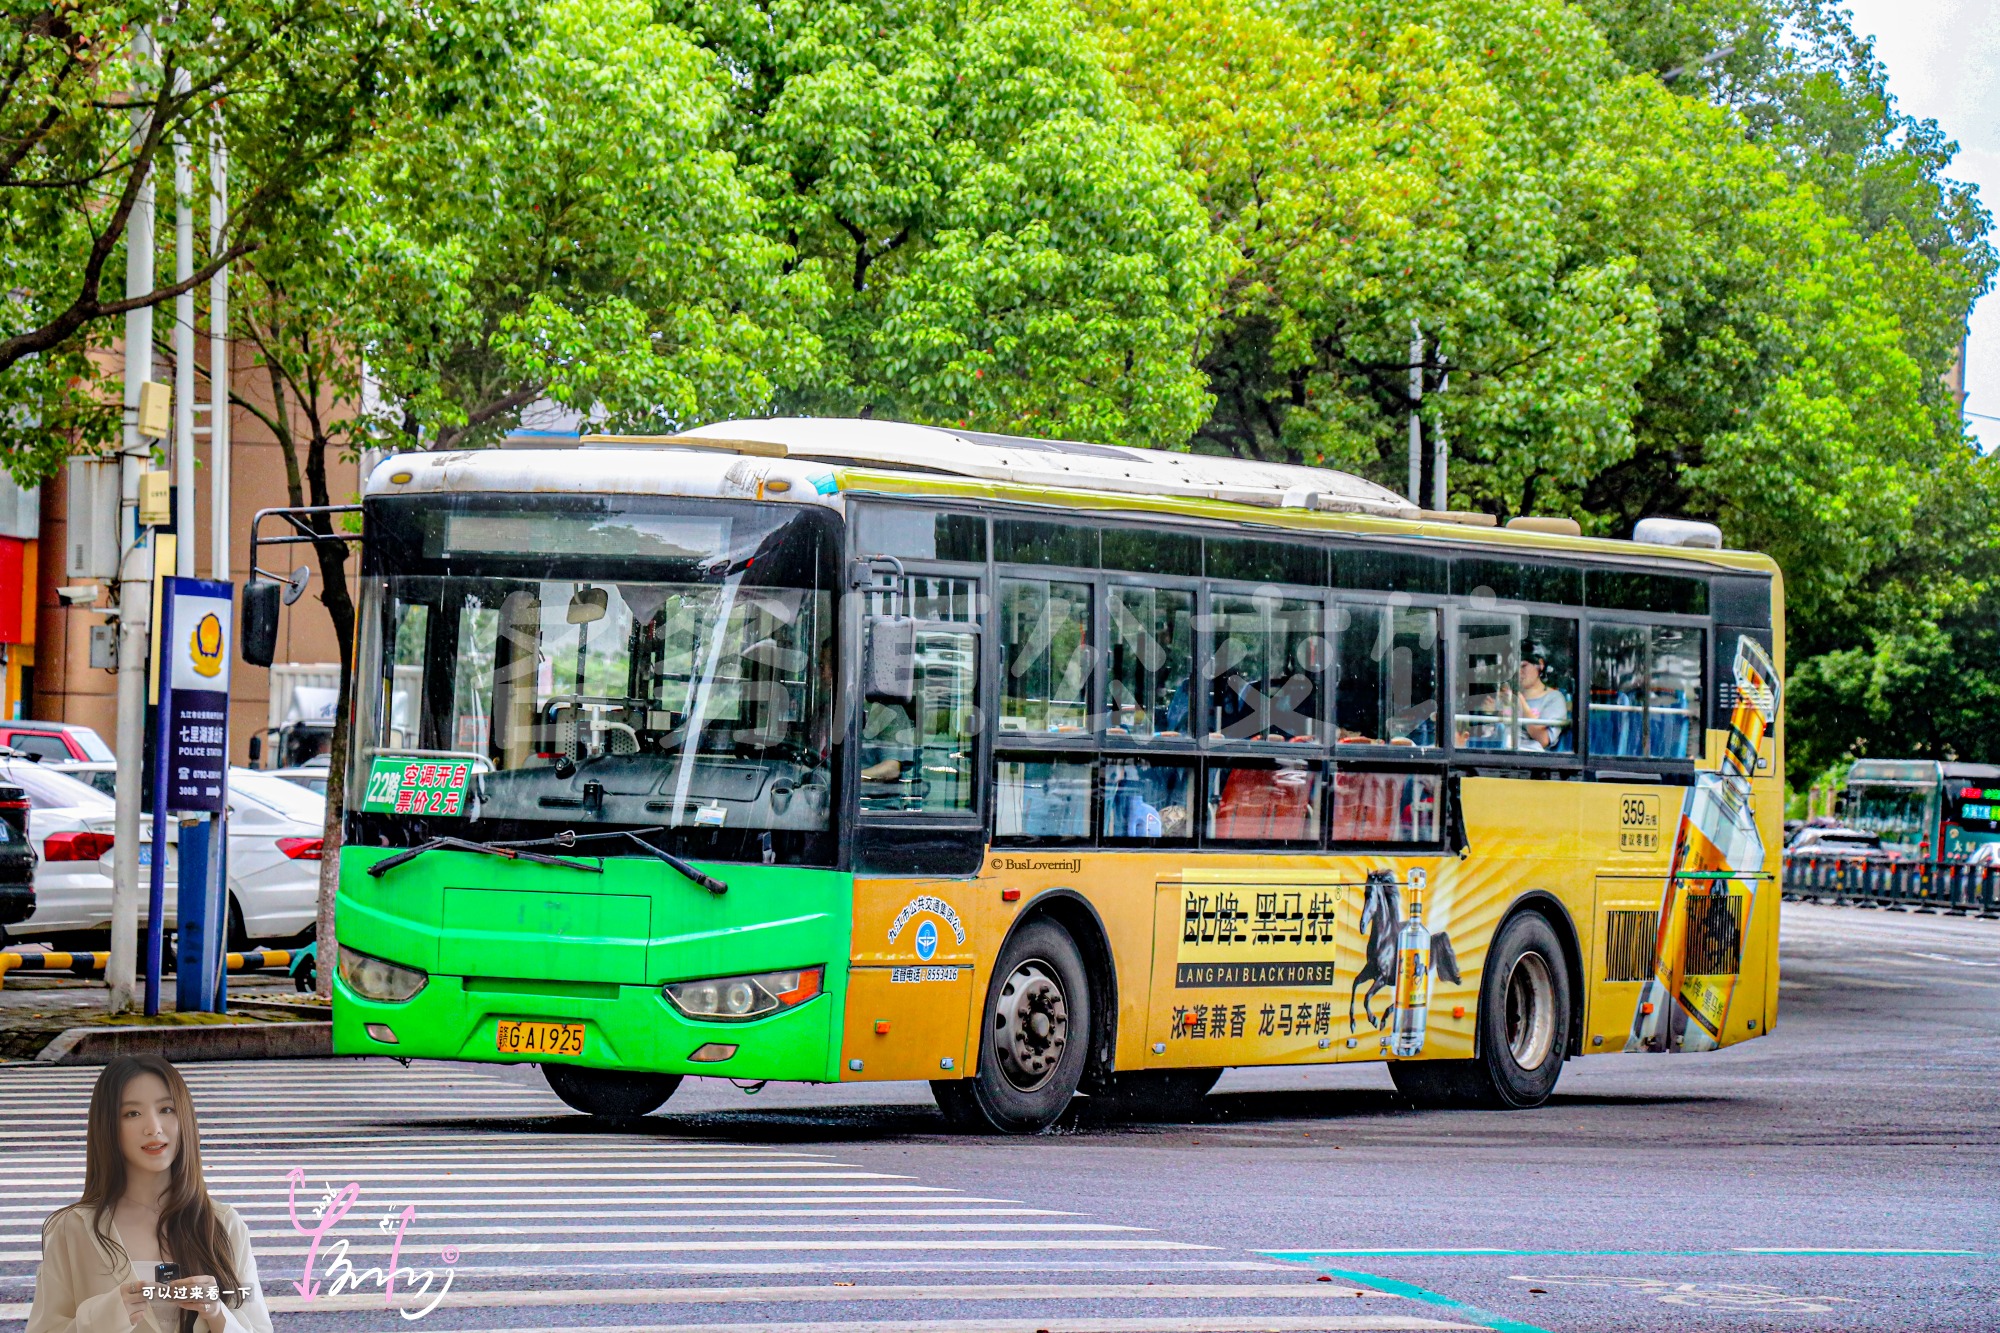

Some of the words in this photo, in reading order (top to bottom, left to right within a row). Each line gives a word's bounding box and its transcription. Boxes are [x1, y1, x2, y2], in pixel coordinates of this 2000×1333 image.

[178, 746, 205, 757] POLICE
[367, 771, 401, 805] 22路
[401, 763, 468, 789] 空调开启
[395, 789, 460, 815] 票价2元
[888, 895, 966, 945] 九江市公共交通集团公司
[1178, 968, 1214, 984] LANG
[1217, 967, 1238, 983] PAI
[1243, 967, 1285, 982] BLACK
[1288, 966, 1332, 982] HORSE
[1170, 1003, 1246, 1040] 浓酱兼香
[1258, 1001, 1331, 1037] 龙马奔腾
